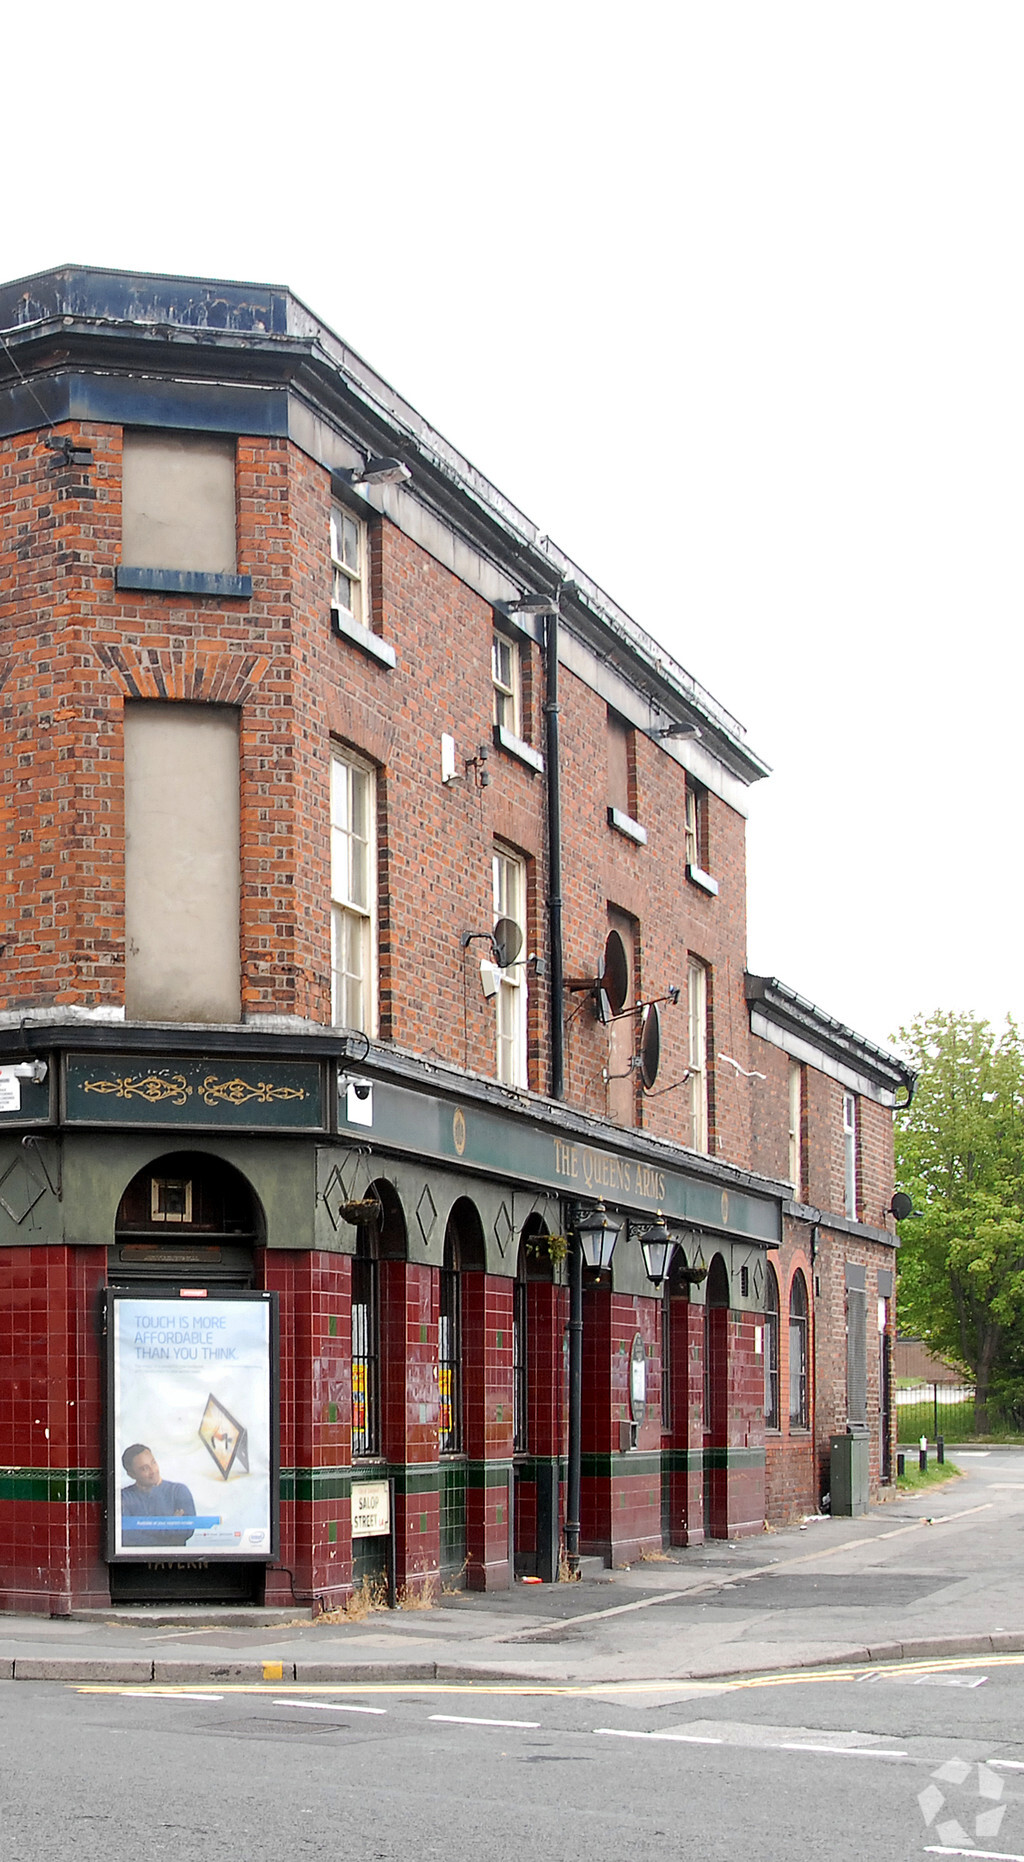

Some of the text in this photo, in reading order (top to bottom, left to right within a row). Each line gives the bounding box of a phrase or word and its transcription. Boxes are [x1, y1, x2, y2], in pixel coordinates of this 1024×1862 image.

[554, 1138, 666, 1200] THE QUEENS ARMS
[134, 1315, 227, 1329] TOUCH IS MORE
[134, 1331, 213, 1345] AFFORDABLE
[135, 1347, 239, 1360] THAN YOU THINK.
[358, 1496, 379, 1510] SALOP
[354, 1514, 377, 1528] STREET
